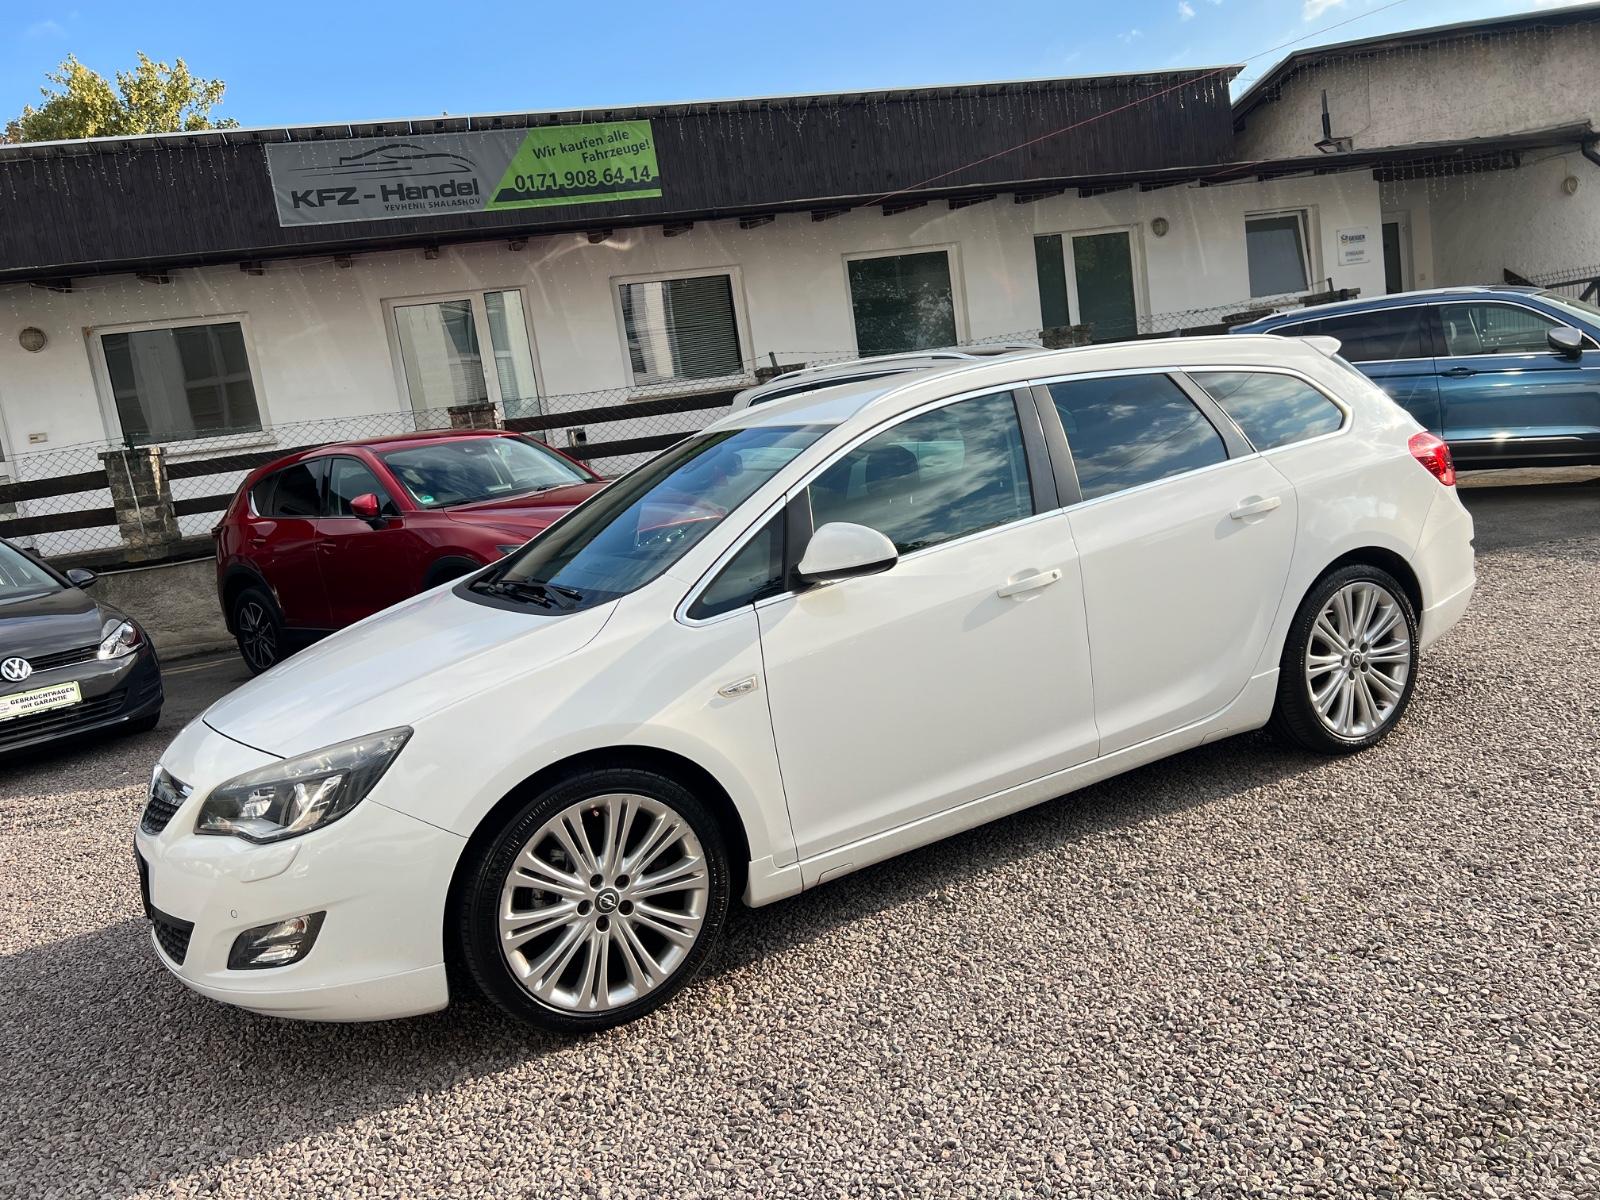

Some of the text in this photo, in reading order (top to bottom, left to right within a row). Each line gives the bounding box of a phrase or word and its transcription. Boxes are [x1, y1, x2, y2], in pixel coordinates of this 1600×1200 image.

[532, 130, 630, 160] Wir kaufen alle
[581, 138, 651, 163] Fahrzeuge!
[514, 165, 651, 191] 0171 908 64 14
[10, 687, 75, 705] GEBRAUCHTWAGEN
[20, 702, 33, 710] mit
[34, 694, 68, 707] GARANTIE
